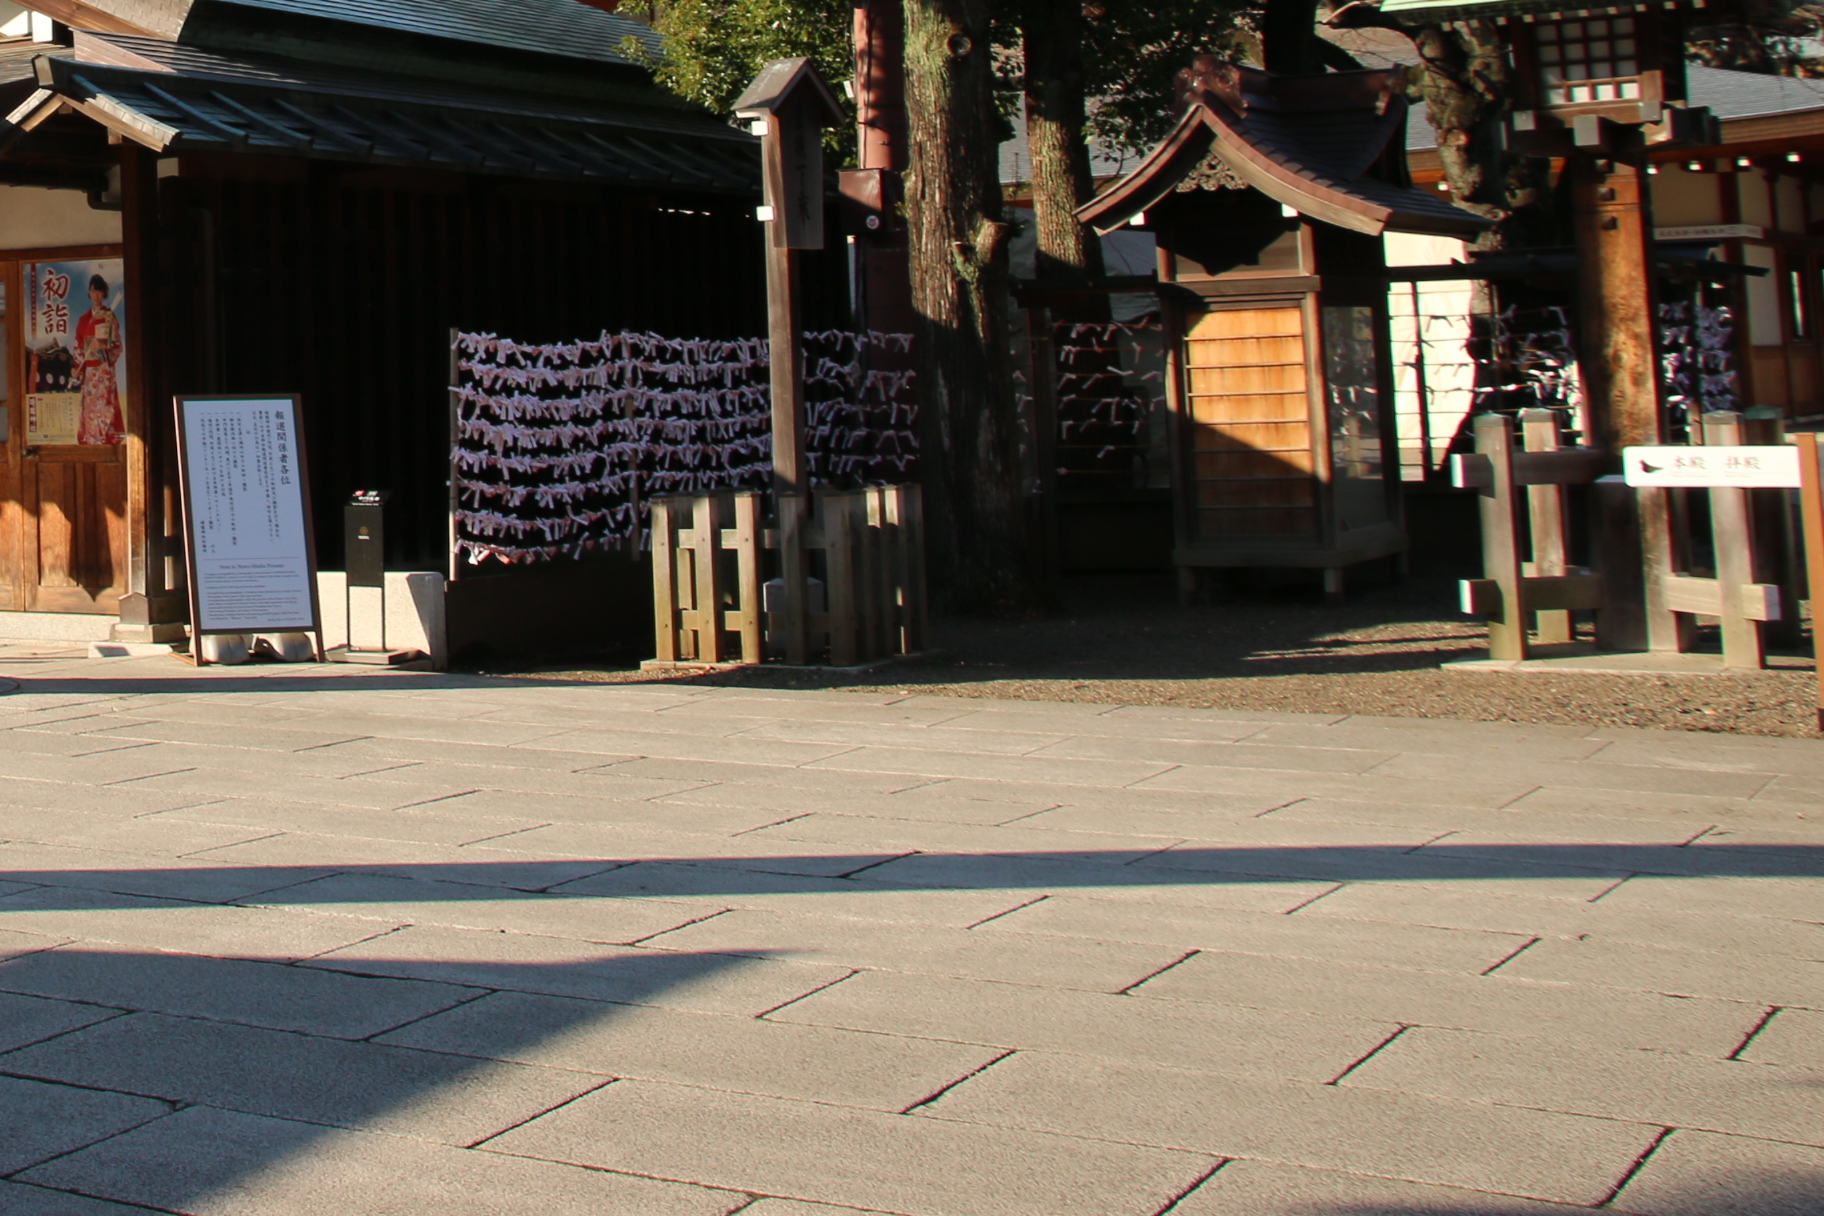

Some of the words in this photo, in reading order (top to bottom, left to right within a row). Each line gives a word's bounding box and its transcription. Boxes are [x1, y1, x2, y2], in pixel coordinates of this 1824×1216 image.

[41, 268, 69, 335] 初詣
[275, 409, 291, 485] 報道関係者各位
[1673, 455, 1707, 469] 本殿
[1724, 455, 1762, 470] 拝殿
